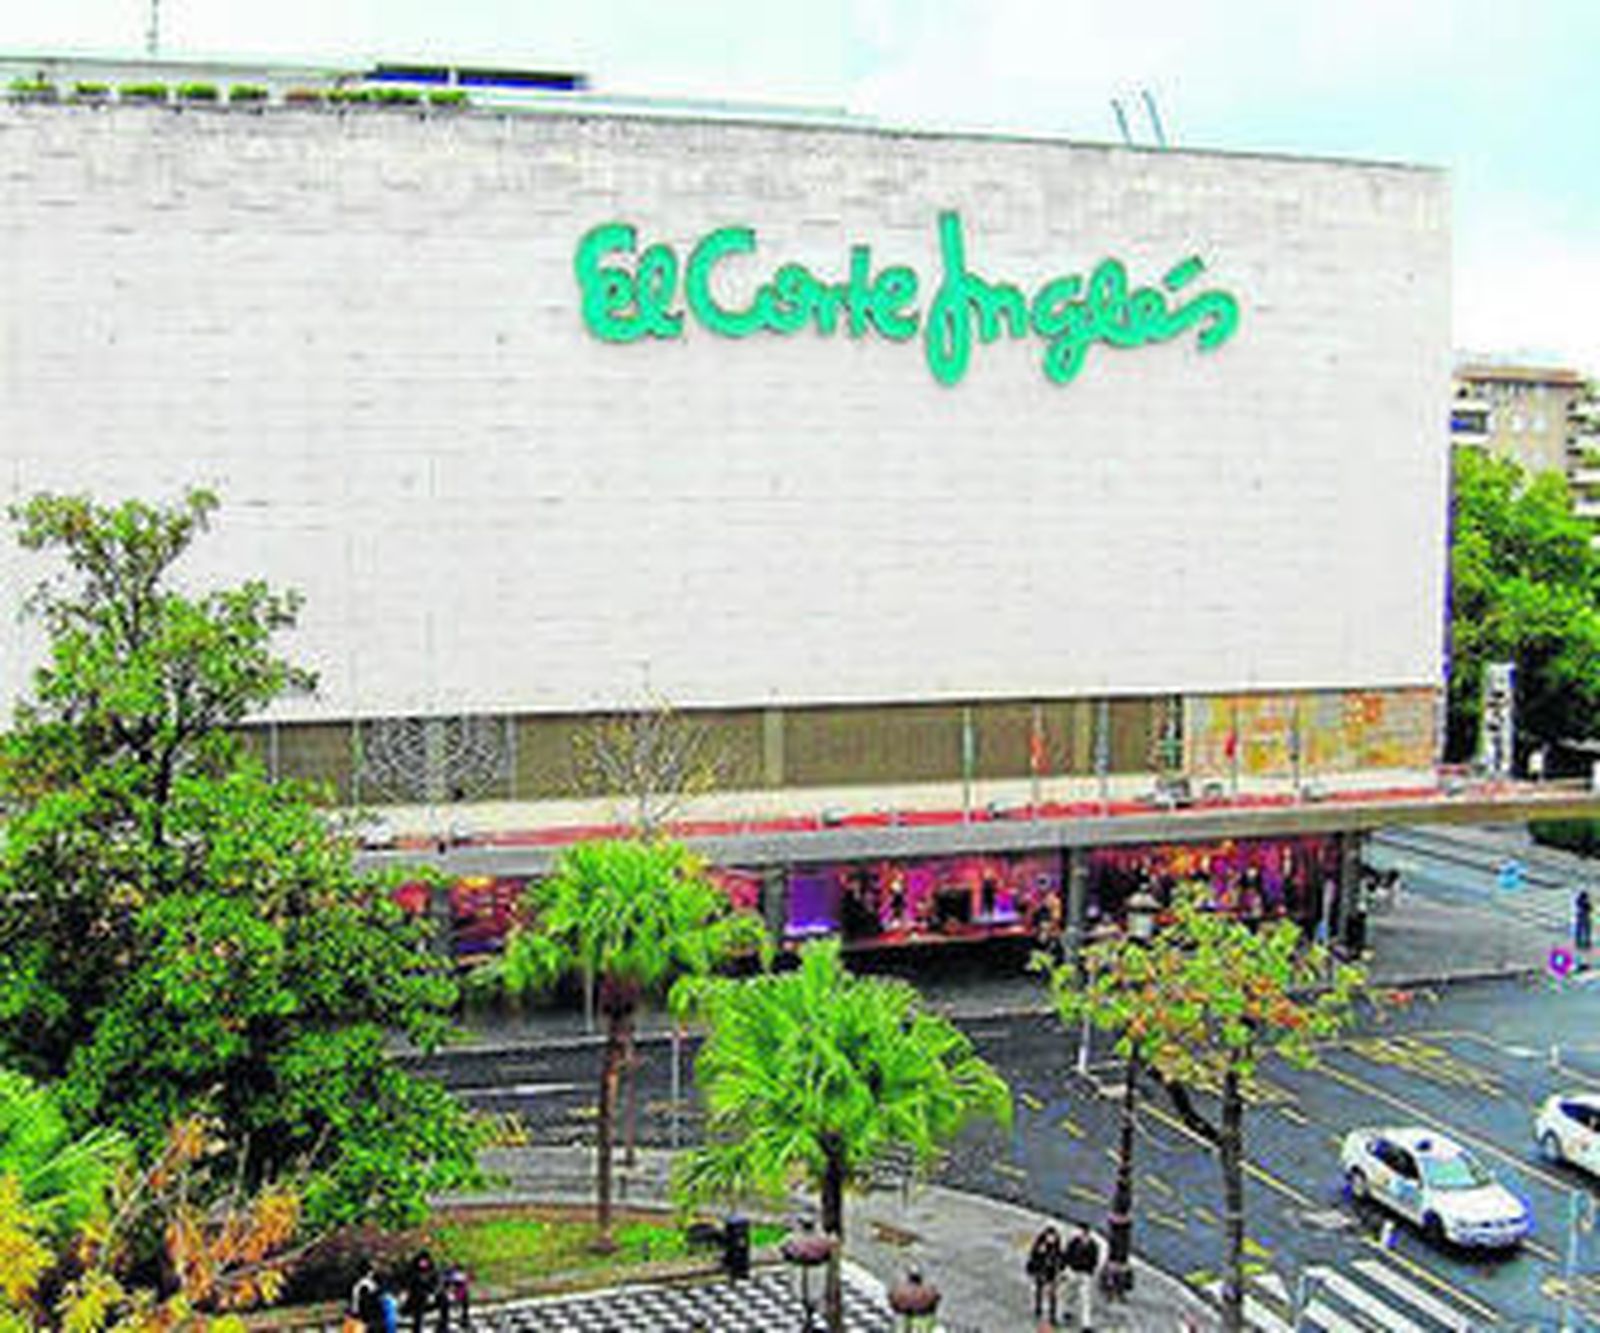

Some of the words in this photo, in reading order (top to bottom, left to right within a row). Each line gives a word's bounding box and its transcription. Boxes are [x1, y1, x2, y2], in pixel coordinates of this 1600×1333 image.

[574, 222, 684, 343] El
[685, 226, 919, 341] Corte
[925, 210, 1241, 386] Inglés
